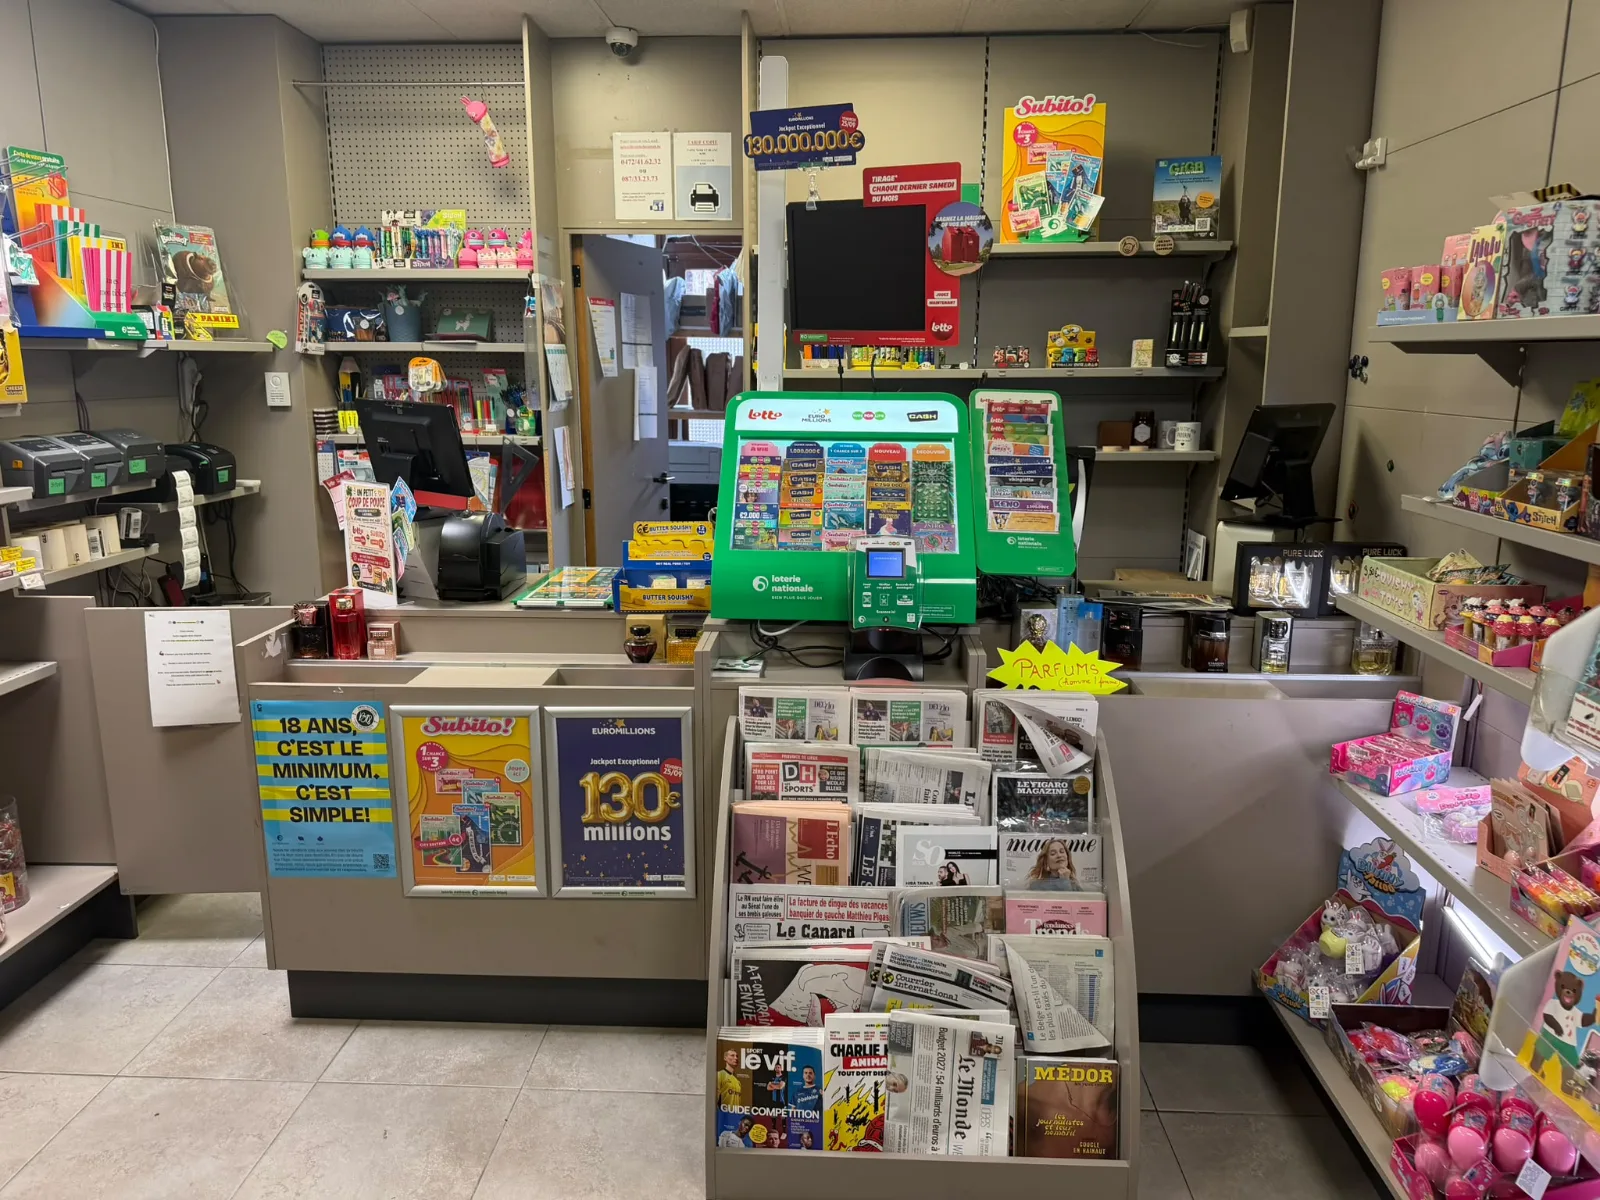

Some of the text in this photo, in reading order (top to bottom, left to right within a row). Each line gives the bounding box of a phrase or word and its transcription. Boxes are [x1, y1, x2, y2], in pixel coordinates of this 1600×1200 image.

[1016, 96, 1094, 116] Subito!
[779, 122, 826, 132] Jackpot Exceptionnel
[746, 130, 863, 156] 130.000.000€
[871, 181, 955, 193] CHAQUE DERNIER SAMEDI
[871, 195, 881, 203] DU
[200, 315, 236, 323] PANINI
[908, 413, 938, 421] CASH
[348, 497, 385, 508] COUP DE POUCE
[993, 500, 1020, 508] KENO
[1362, 548, 1381, 556] PURE
[772, 575, 801, 583] loterie
[772, 584, 813, 592] nationale
[1013, 658, 1099, 679] PARFUMS
[279, 717, 357, 737] 18 ANS,
[423, 717, 514, 733] Subito!
[277, 738, 364, 757] C'EST LE
[430, 757, 439, 767] 3
[590, 758, 660, 766] Jackpot Exceptionnel
[272, 762, 380, 780] MINIMUM.
[295, 783, 353, 801] C'EST
[1030, 781, 1068, 789] FIGARO
[289, 806, 371, 823] SIMPLE!
[584, 822, 672, 841] millions
[826, 821, 840, 859] L'Echo
[862, 855, 876, 877] LE
[789, 897, 888, 910] La facture de dingue des vacances
[789, 910, 814, 920] banquier
[815, 910, 822, 918] de
[824, 911, 845, 921] gauche
[847, 911, 872, 921] Matthieu
[777, 922, 855, 938] Le Canard
[896, 974, 935, 988] Courrier
[894, 981, 959, 1001] international
[1032, 990, 1041, 1009] est-il
[1037, 1014, 1045, 1031] Belge
[1041, 991, 1056, 1041] les plus taxés
[936, 1027, 948, 1053] Budget
[1039, 1032, 1046, 1041] Le
[831, 1044, 880, 1057] CHARLIE
[741, 1048, 797, 1072] le vif.
[937, 1053, 947, 1071] 2027
[936, 1075, 945, 1085] 54
[1034, 1064, 1113, 1084] MÉDOR
[933, 1086, 943, 1117] milliards
[955, 1054, 976, 1139] Le Monde
[721, 1104, 819, 1119] GUIDE COMPÉTITION
[1036, 1118, 1084, 1127] journalistes
[932, 1118, 942, 1145] d'euros
